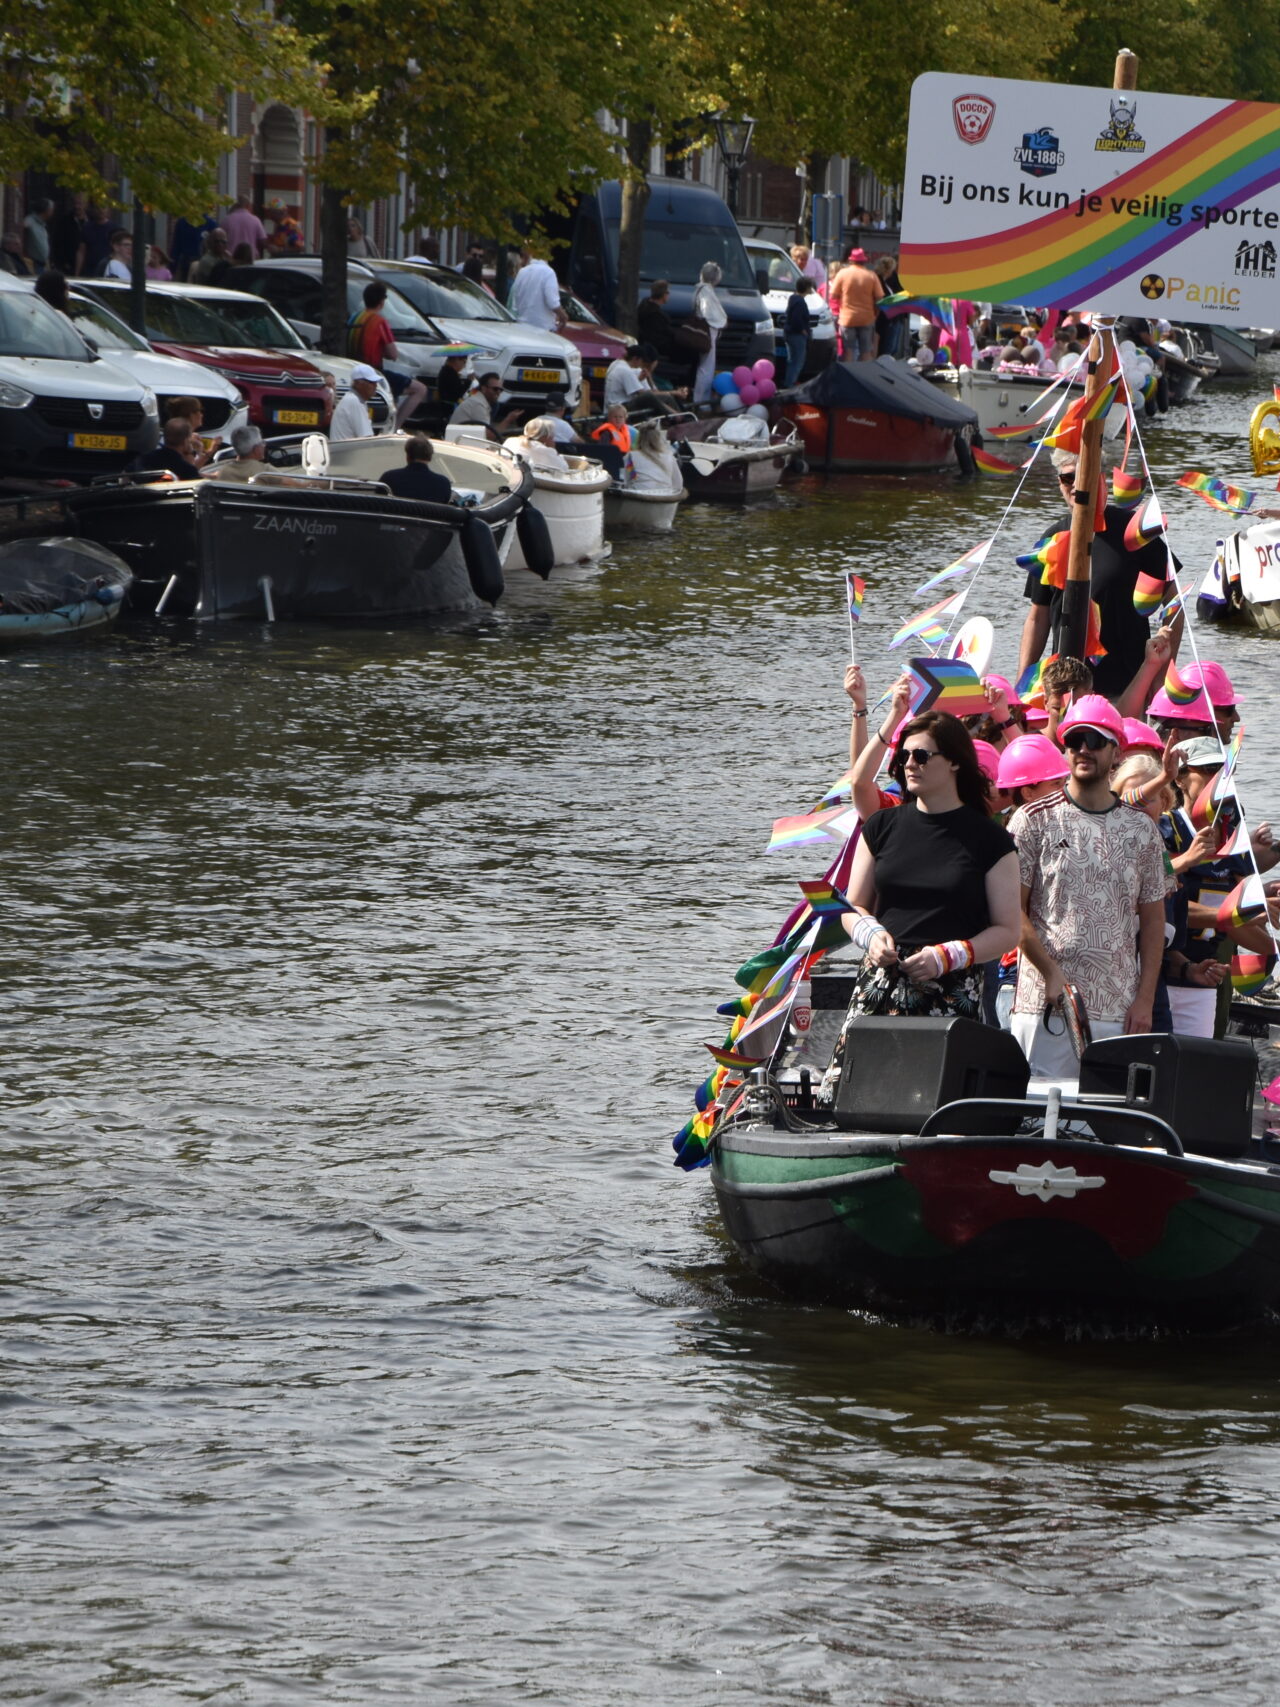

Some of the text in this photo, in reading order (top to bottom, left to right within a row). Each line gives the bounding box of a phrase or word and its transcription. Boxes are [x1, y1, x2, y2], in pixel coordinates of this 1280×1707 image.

[960, 103, 988, 115] DOCOS
[1014, 147, 1064, 166] ZVL-1886
[920, 174, 953, 205] Bij
[962, 182, 1010, 204] ons
[1018, 183, 1069, 209] kun
[1075, 189, 1102, 217] je
[1110, 195, 1184, 227] veilig
[1234, 269, 1275, 279] LEIDEN
[1166, 277, 1241, 305] Panic
[253, 514, 337, 535] ZAANdam
